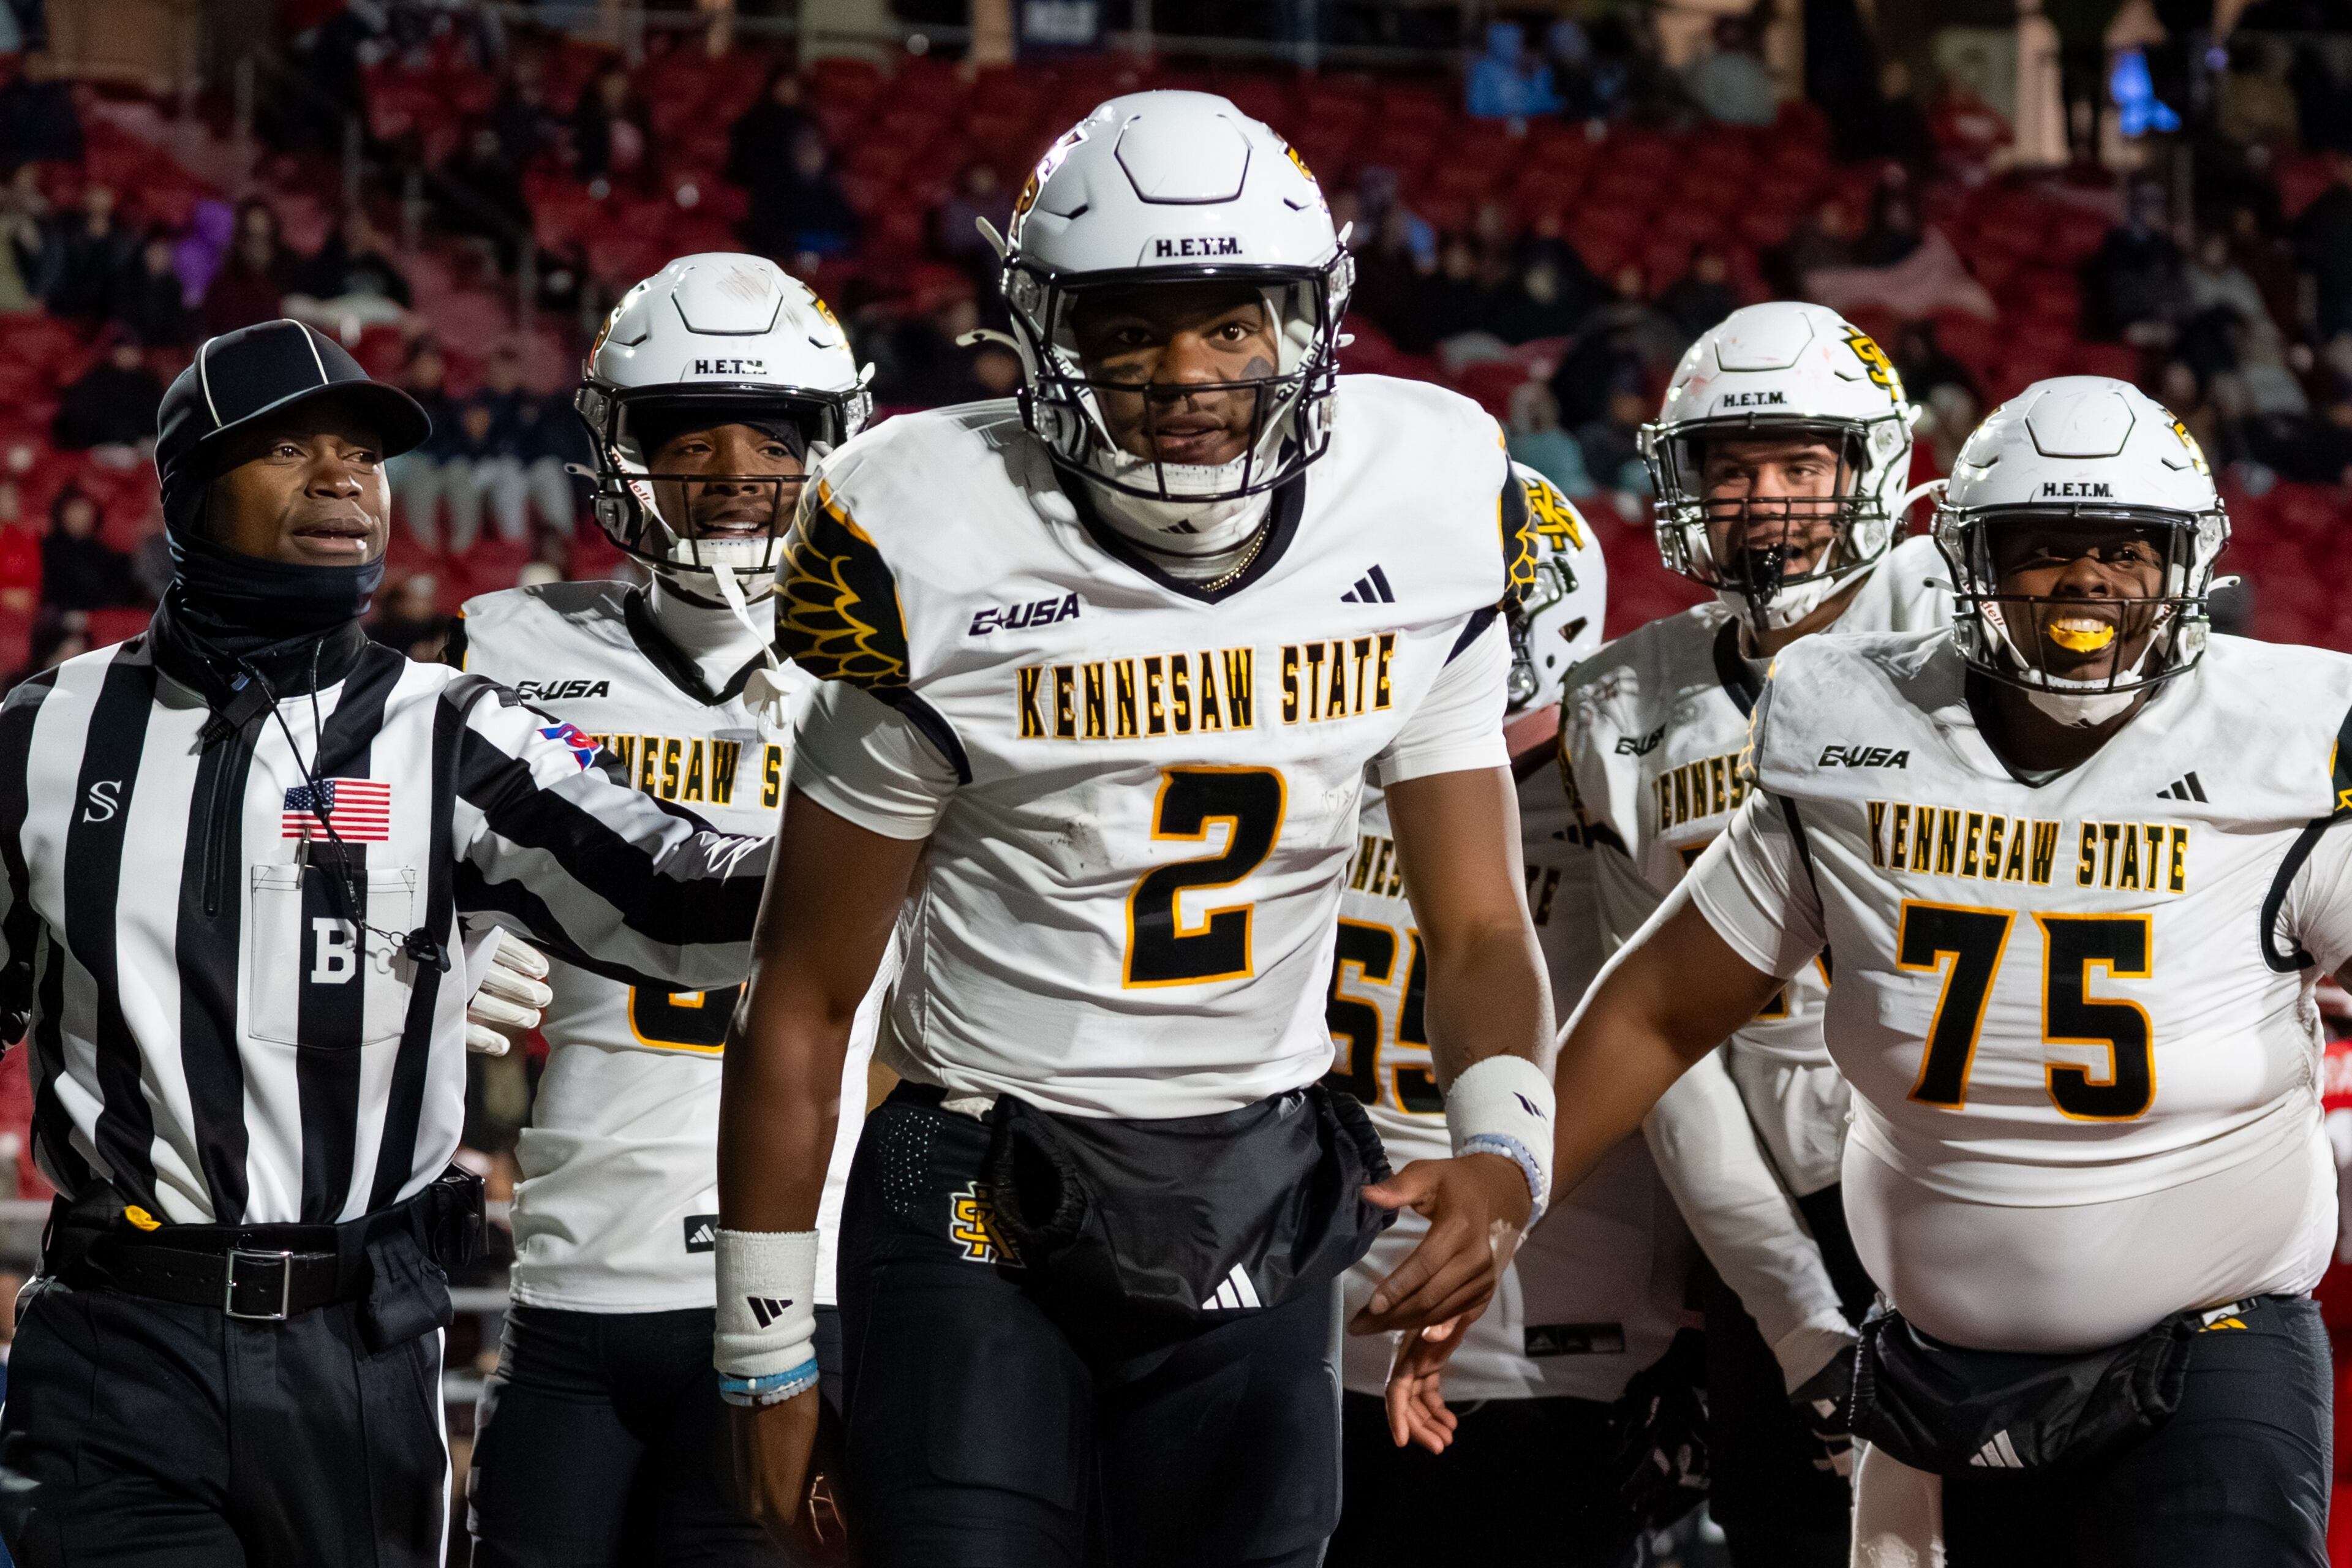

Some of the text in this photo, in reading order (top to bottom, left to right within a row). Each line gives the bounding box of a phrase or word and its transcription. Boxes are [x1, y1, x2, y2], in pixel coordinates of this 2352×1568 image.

[1156, 238, 1243, 257] H.E.T.M.
[1724, 391, 1787, 407] H.E.T.M.
[2042, 482, 2113, 497] H.E.T.M.
[1016, 633, 1399, 739] KENNESAW STATE
[83, 780, 122, 823] S
[1121, 765, 1287, 990] 2
[1866, 800, 2190, 894] KENNESAW STATE
[311, 917, 358, 984] B
[1896, 898, 2156, 1122] 75
